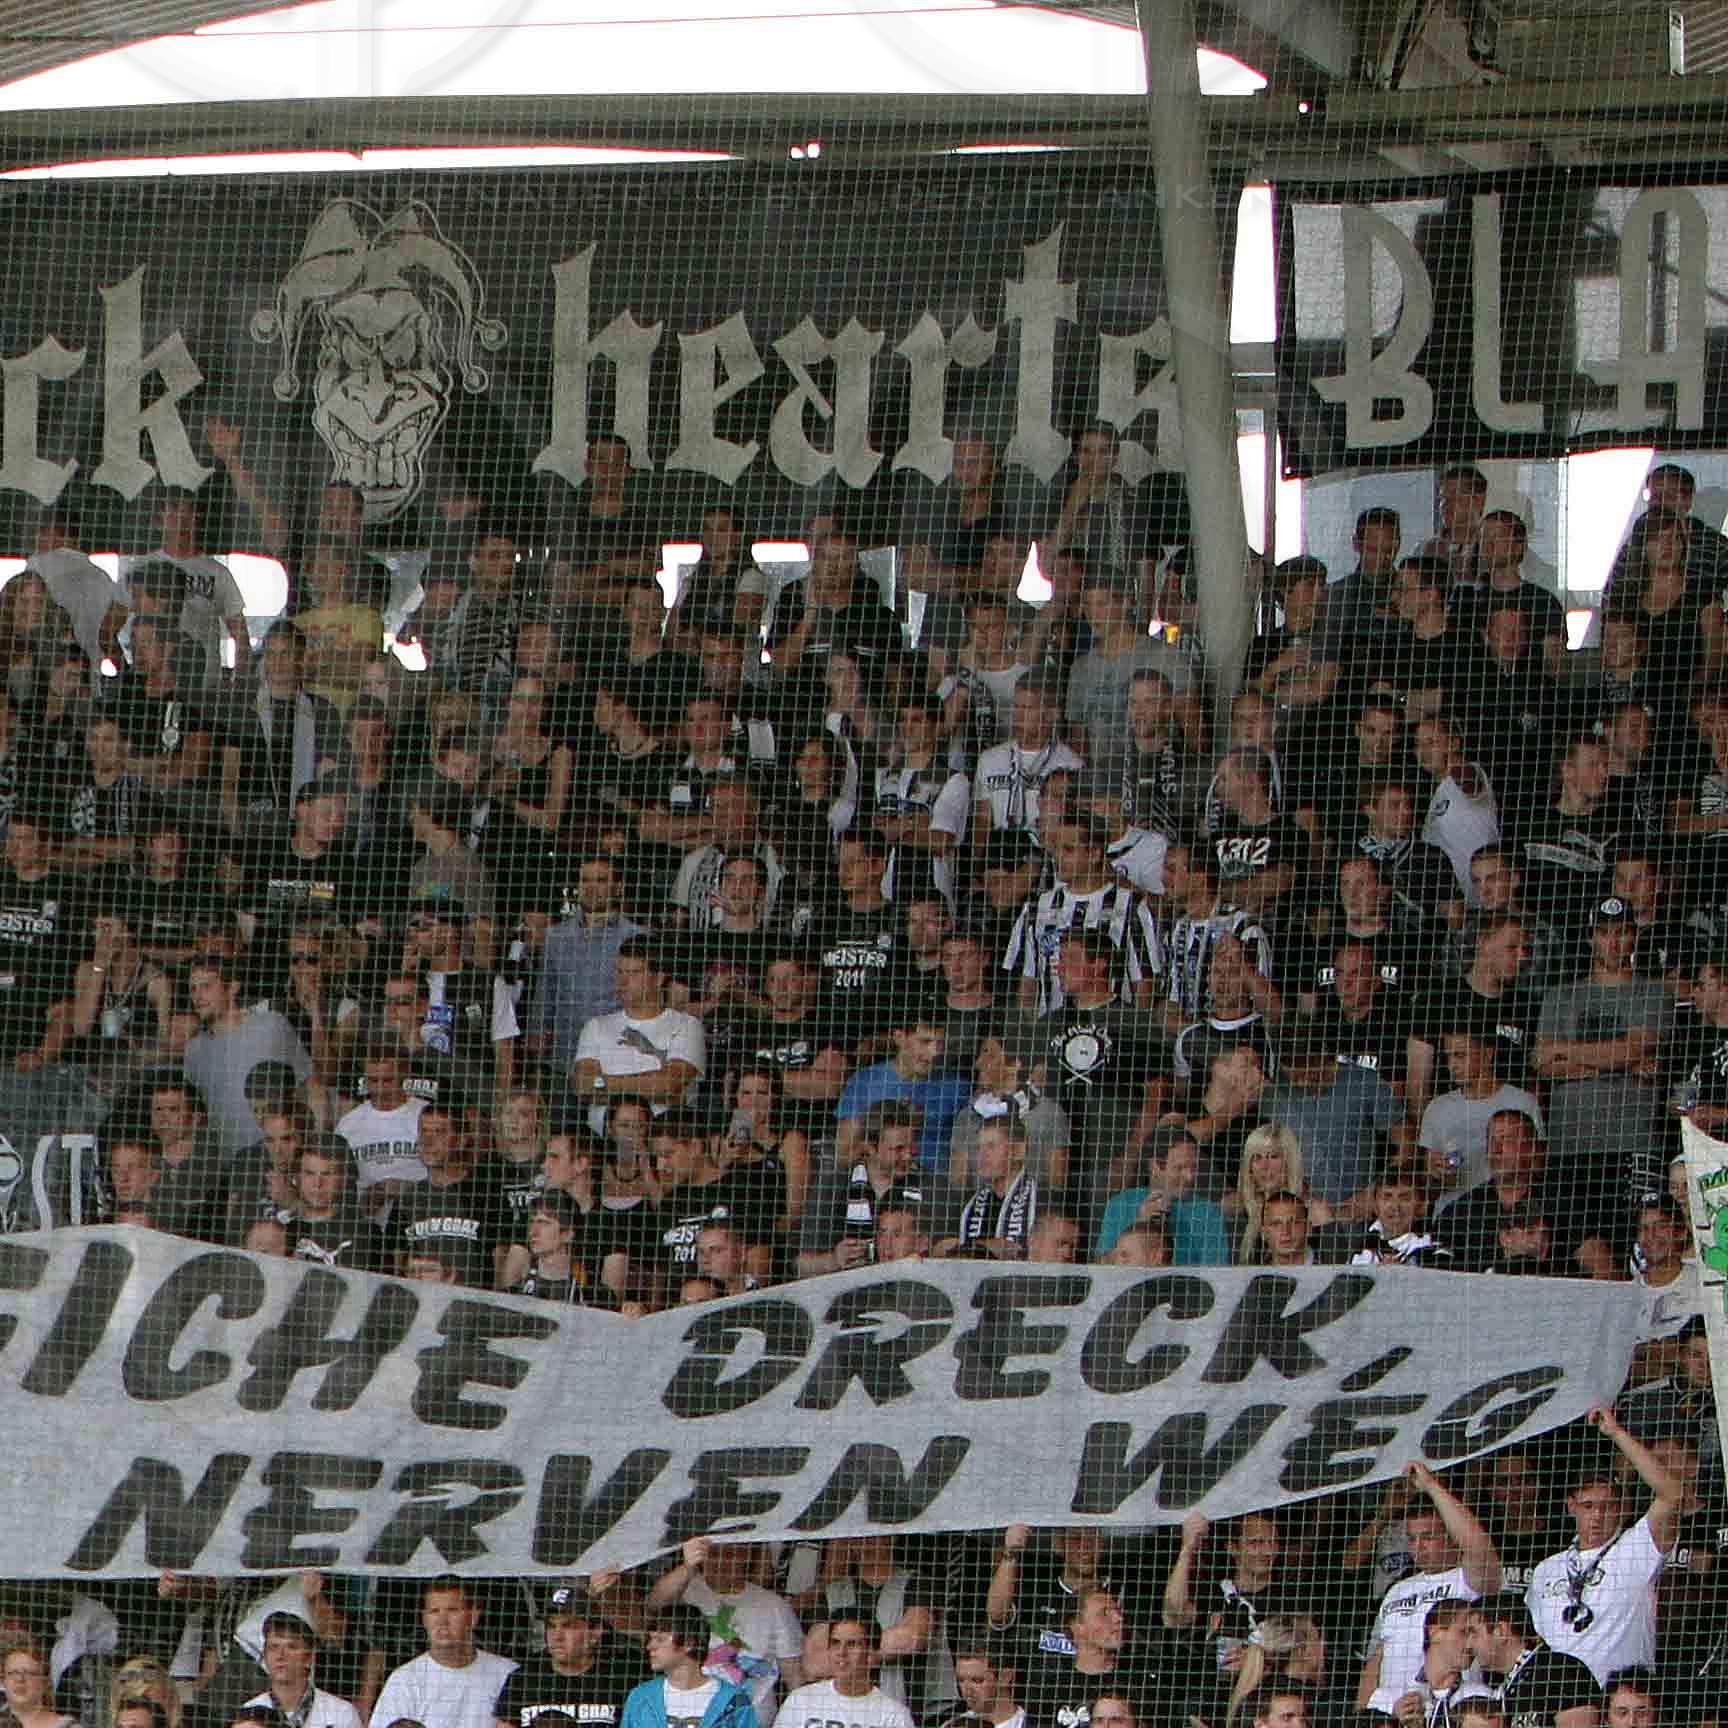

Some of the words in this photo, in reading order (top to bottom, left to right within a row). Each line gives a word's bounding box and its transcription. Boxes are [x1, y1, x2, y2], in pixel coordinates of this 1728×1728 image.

[534, 220, 1186, 490] hearts
[823, 949, 887, 971] MEISTER
[64, 1435, 972, 1575] NERVEN
[576, 1702, 617, 1726] GRAZ
